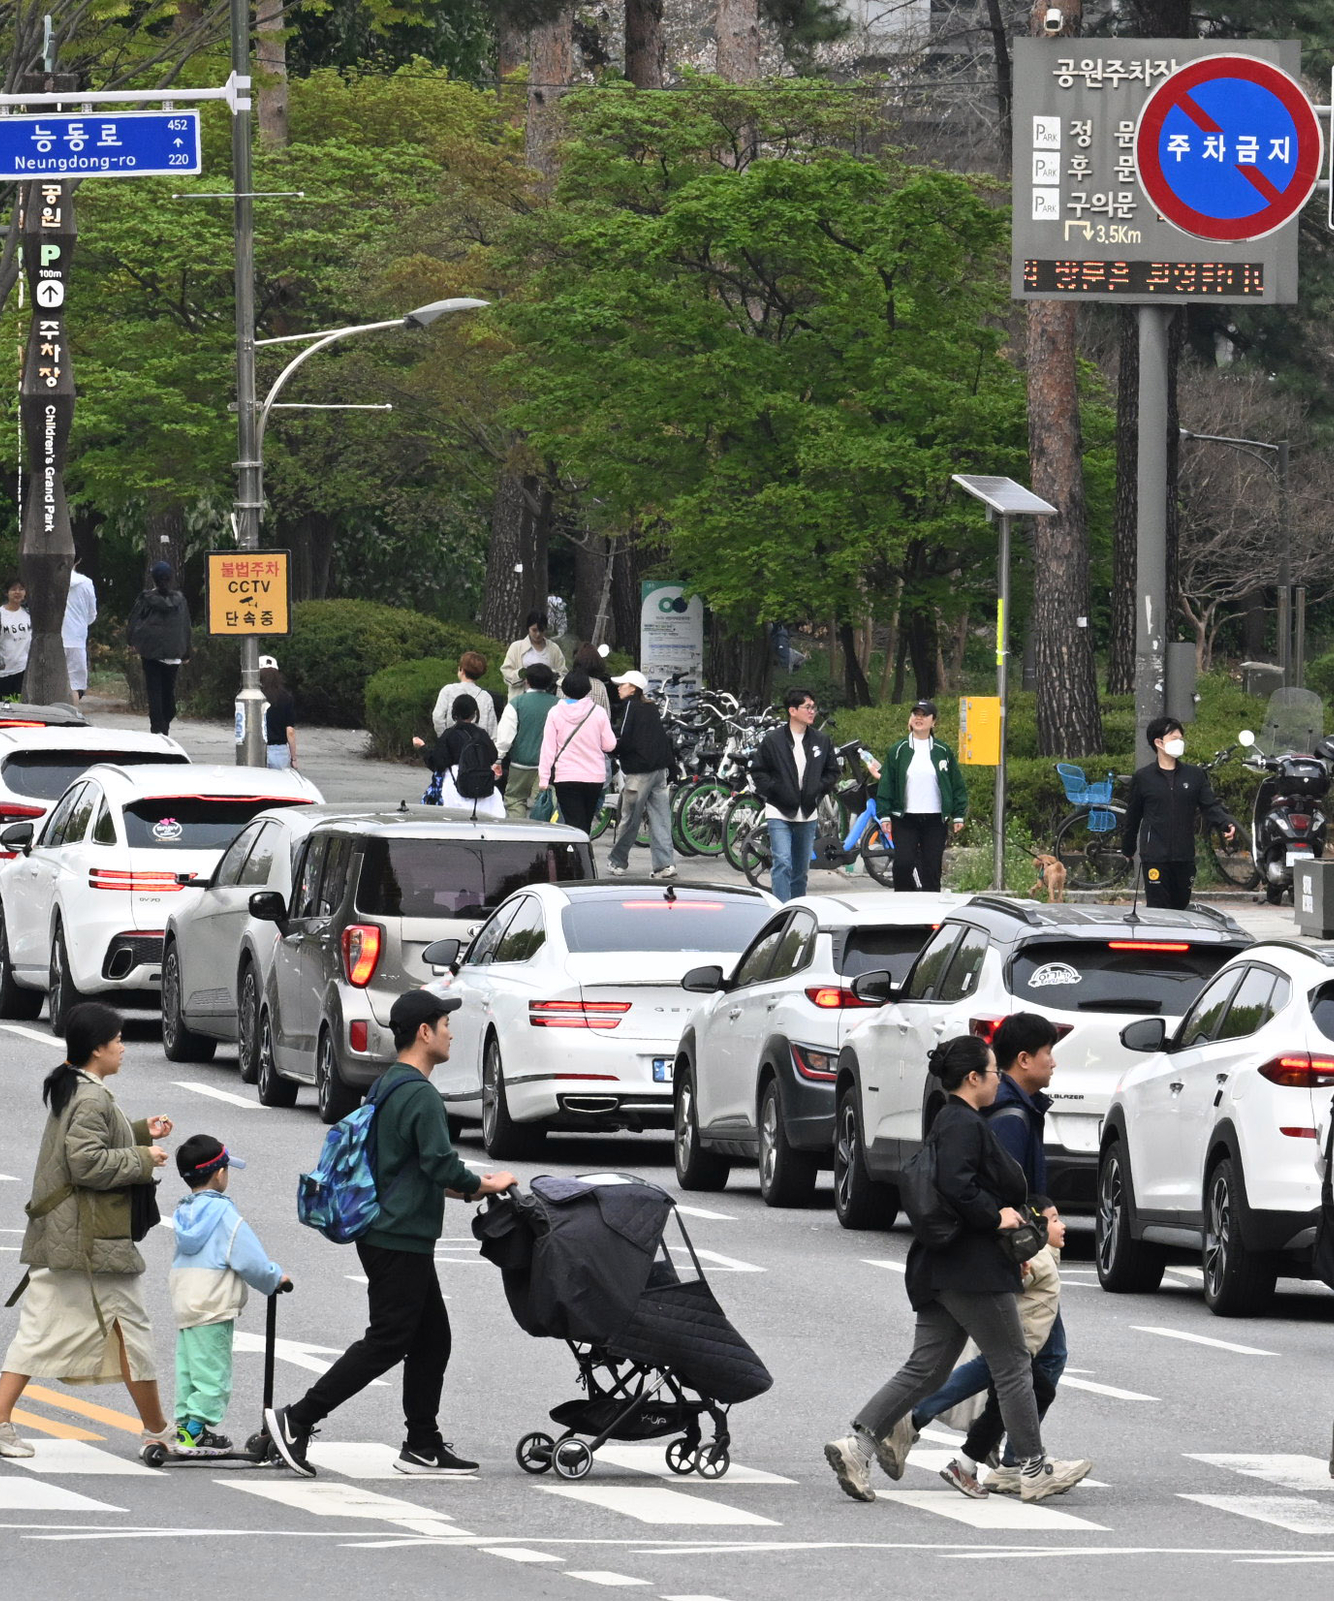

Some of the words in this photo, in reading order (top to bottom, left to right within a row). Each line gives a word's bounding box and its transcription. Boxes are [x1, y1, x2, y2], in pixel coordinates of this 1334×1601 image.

[167, 119, 188, 131] 452
[30, 123, 123, 153] 능동로
[1167, 134, 1290, 164] 주차금지
[15, 156, 136, 172] Neungdong-ro
[168, 154, 189, 166] 220
[1067, 191, 1137, 219] 구의문
[40, 244, 61, 267] P
[38, 269, 62, 279] 100m
[38, 320, 62, 388] 주차장
[44, 405, 57, 465] Children's
[44, 466, 56, 503] Grand
[44, 505, 55, 532] Park
[220, 561, 280, 578] 불법주차
[228, 580, 271, 594] CCTV
